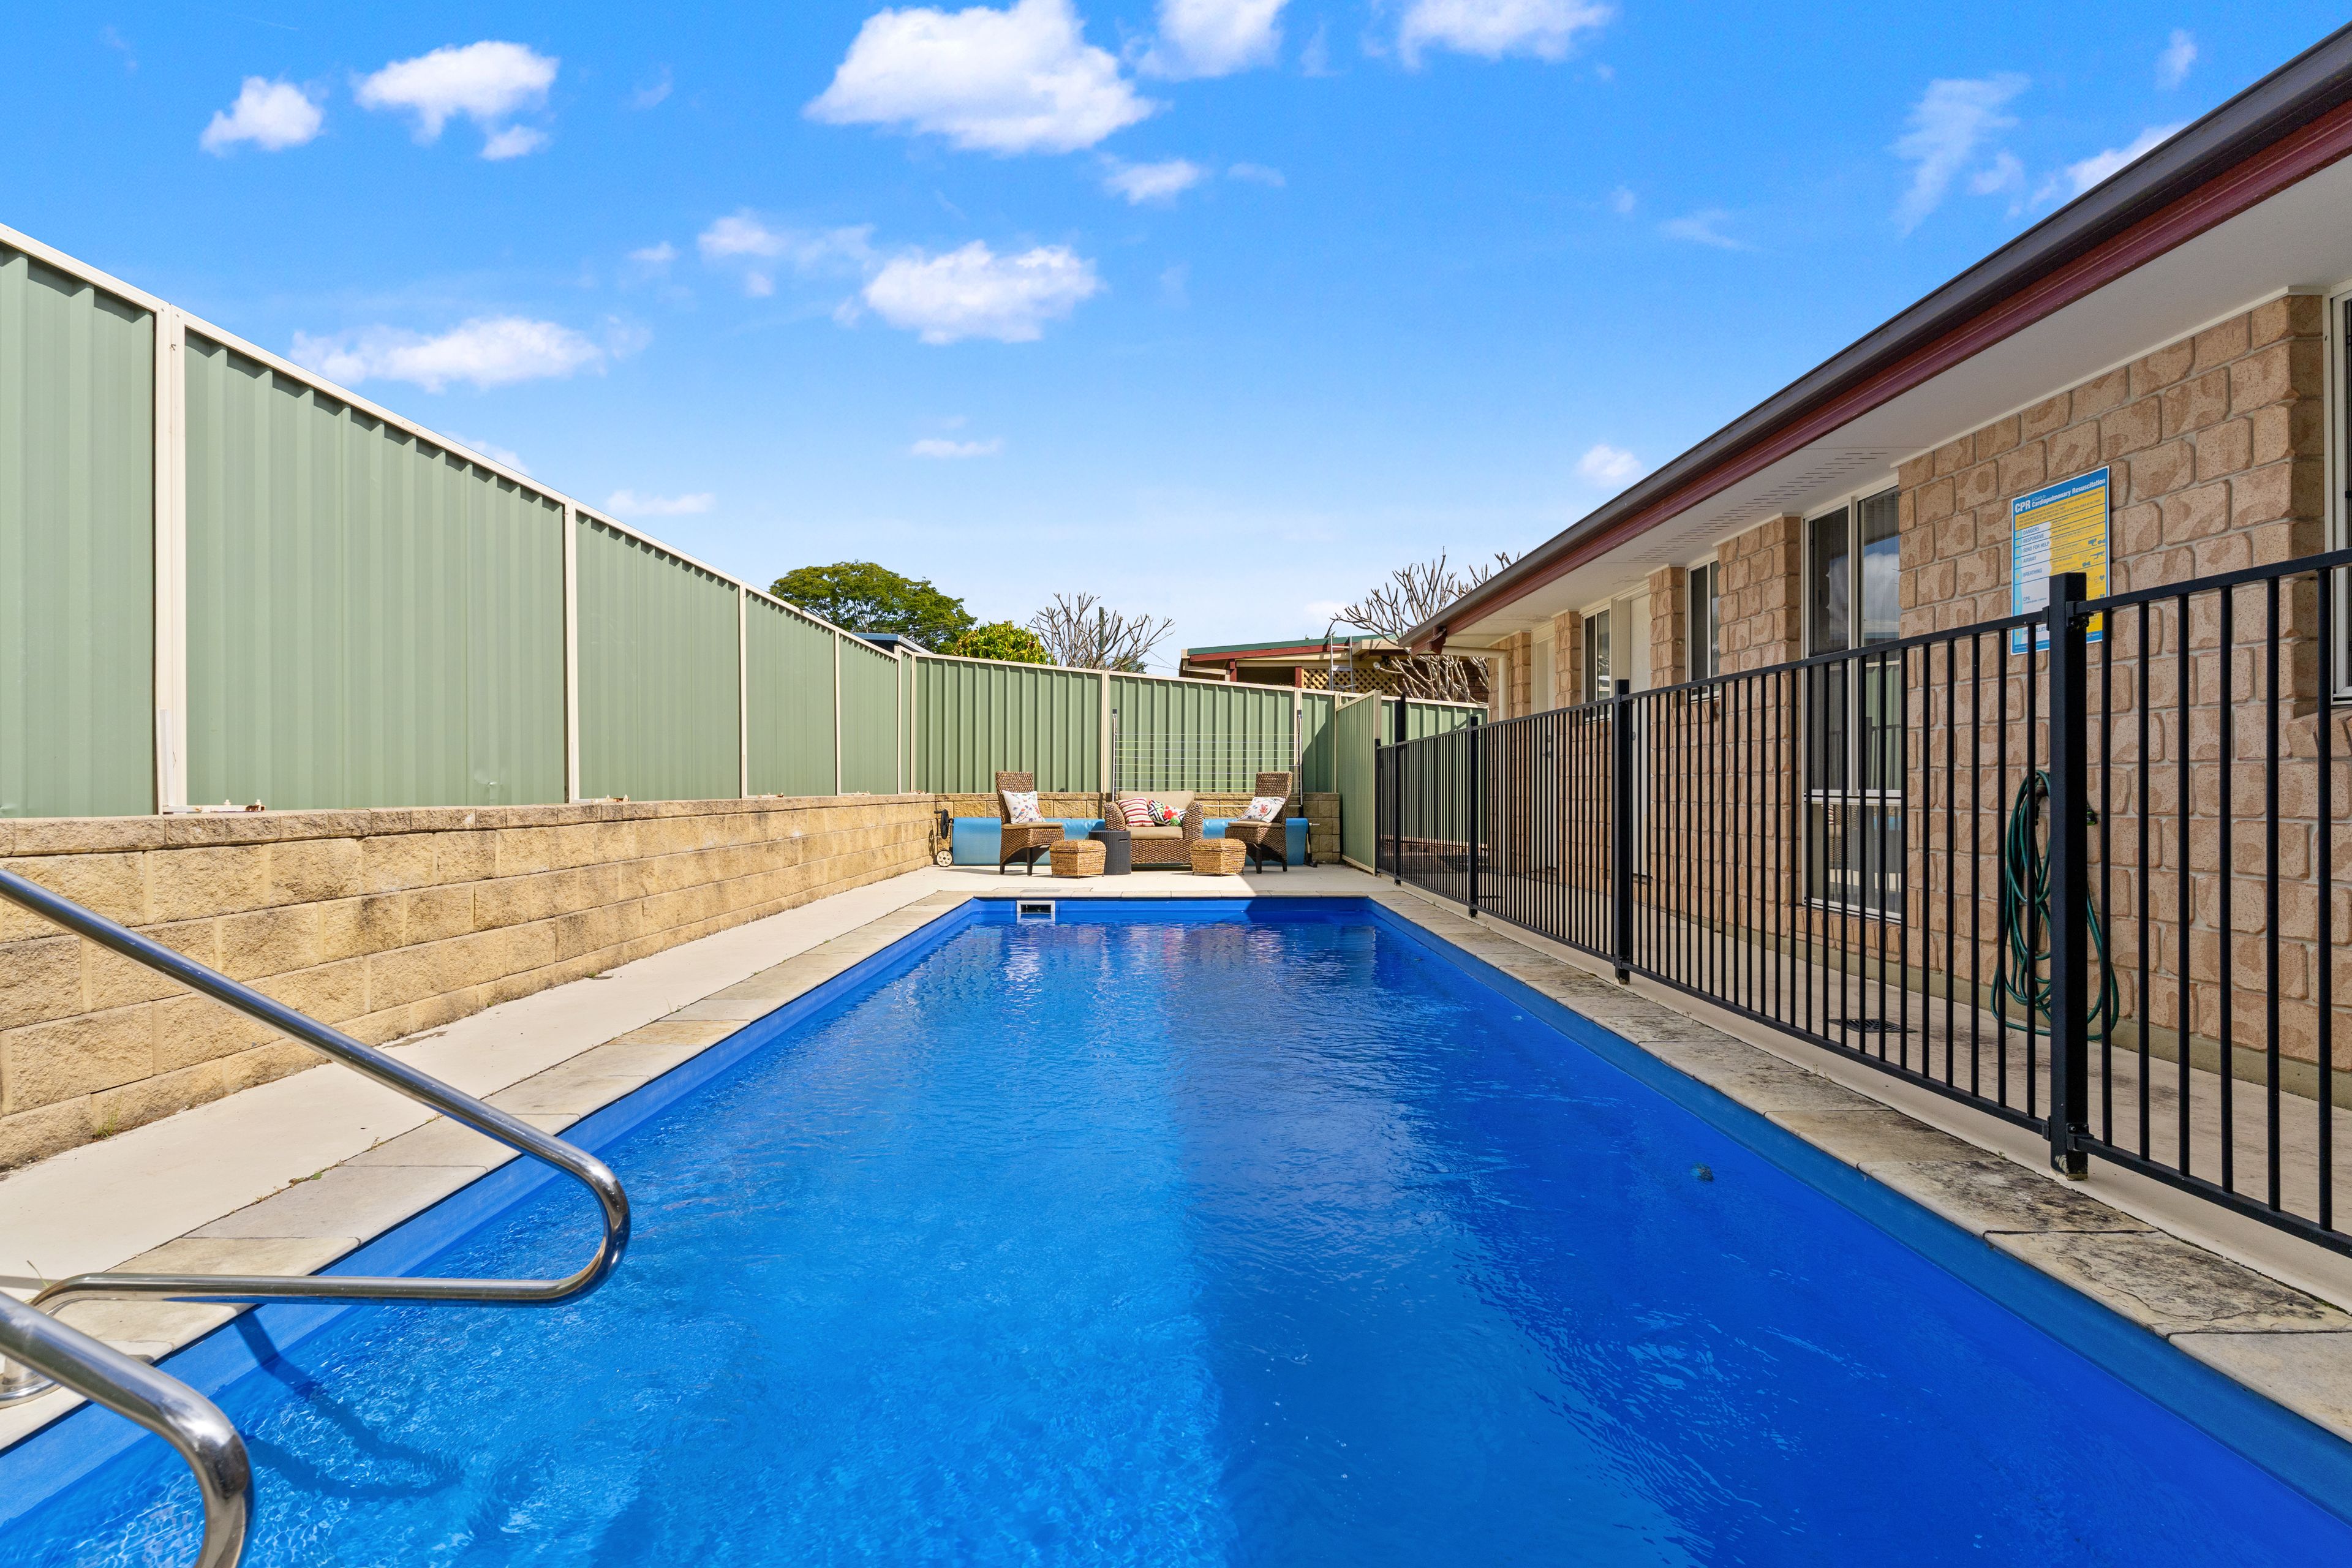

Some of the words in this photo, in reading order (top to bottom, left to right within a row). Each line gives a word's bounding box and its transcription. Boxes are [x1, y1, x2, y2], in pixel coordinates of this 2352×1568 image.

[2032, 490, 2071, 507] Cardiopulmonary
[2072, 478, 2106, 494] Resuscitation
[2015, 500, 2031, 513] CPR
[2023, 533, 2045, 543] RESPONSIVE
[2023, 568, 2043, 577] BREATHING
